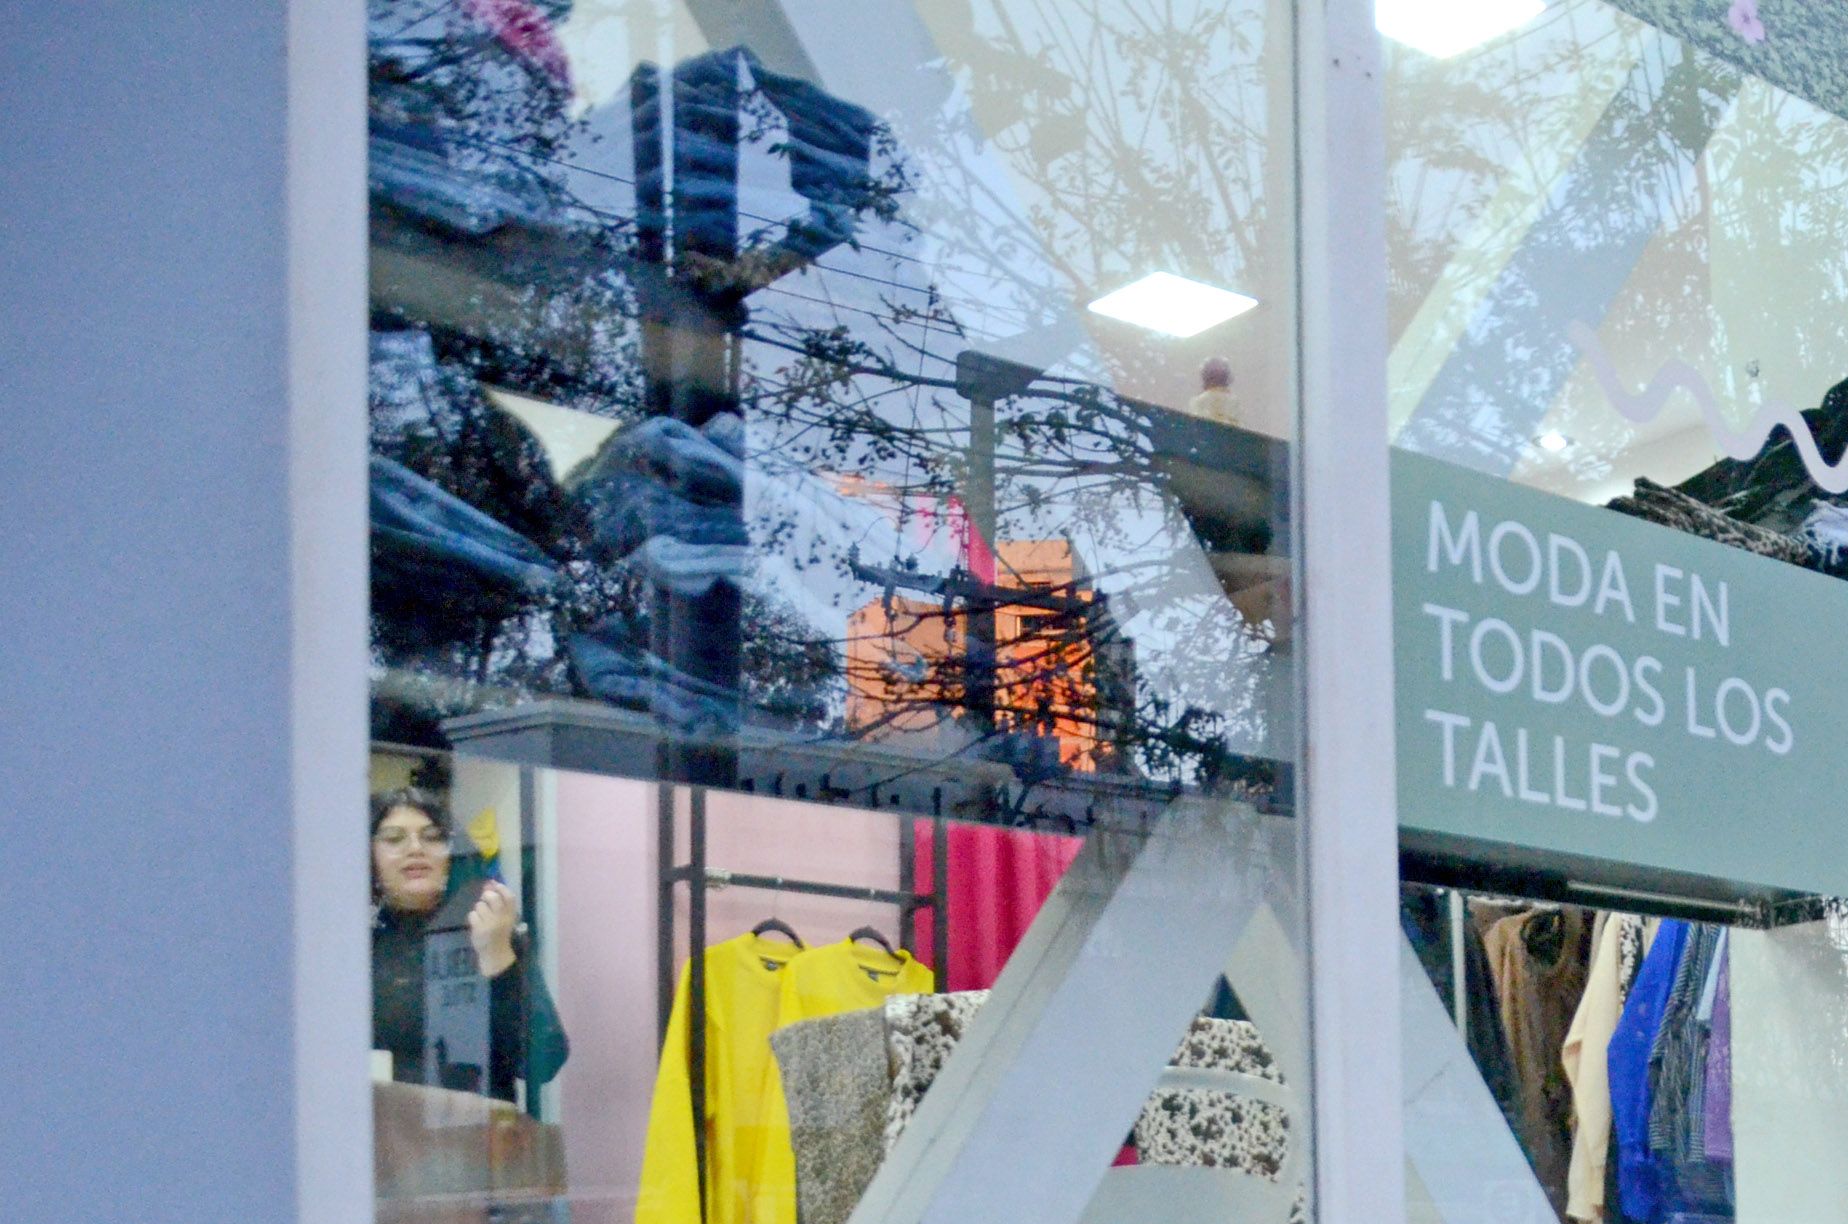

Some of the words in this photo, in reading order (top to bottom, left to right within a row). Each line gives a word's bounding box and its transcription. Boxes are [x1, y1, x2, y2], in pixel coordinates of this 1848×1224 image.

[1426, 499, 1635, 623] MODA
[1655, 563, 1730, 648] EN
[1423, 602, 1665, 726] TODOS
[1686, 666, 1793, 754] LOS
[1424, 709, 1658, 823] TALLES
